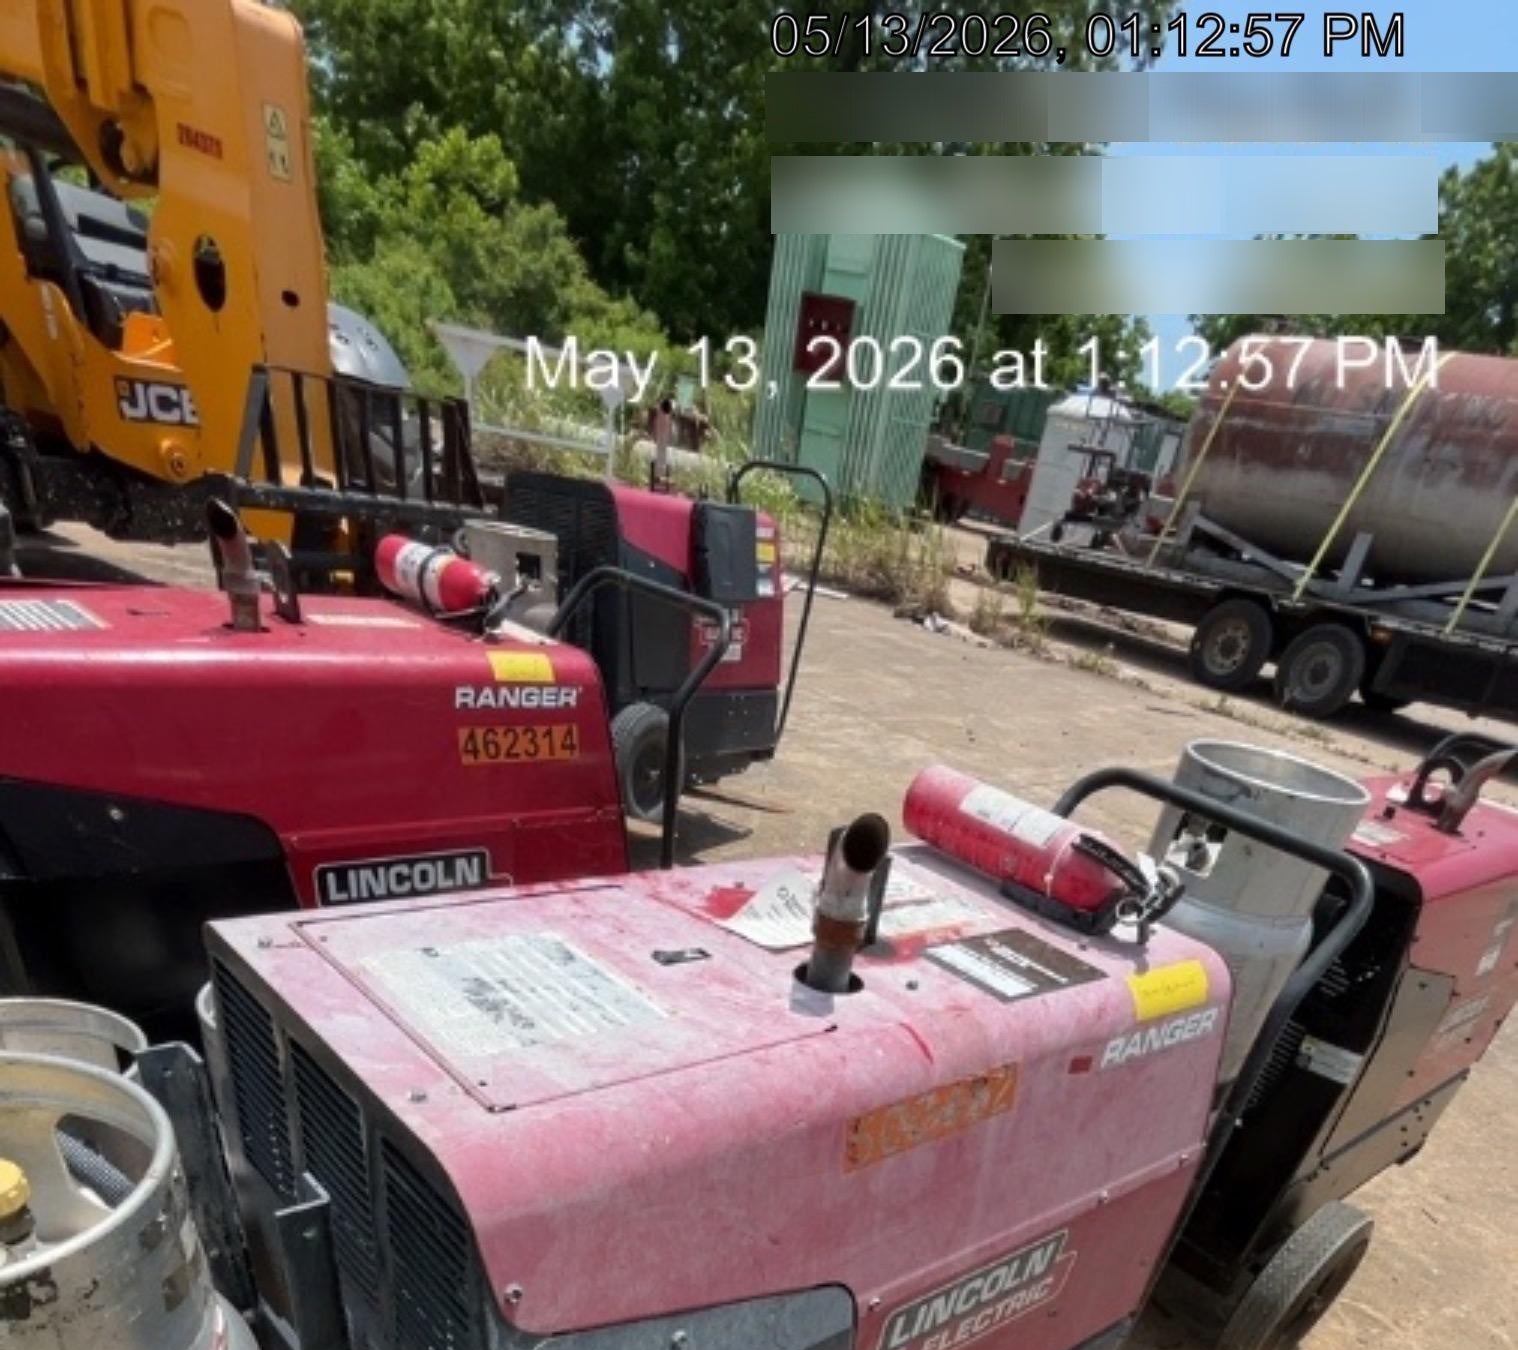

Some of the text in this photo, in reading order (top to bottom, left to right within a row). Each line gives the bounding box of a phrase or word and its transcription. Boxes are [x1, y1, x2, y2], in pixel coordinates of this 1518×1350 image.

[455, 686, 578, 709] RANGER
[463, 727, 577, 760] 462314
[327, 858, 480, 901] LINCOLN
[1101, 1009, 1217, 1068] RANGER
[889, 1243, 1058, 1348] LINCOLN
